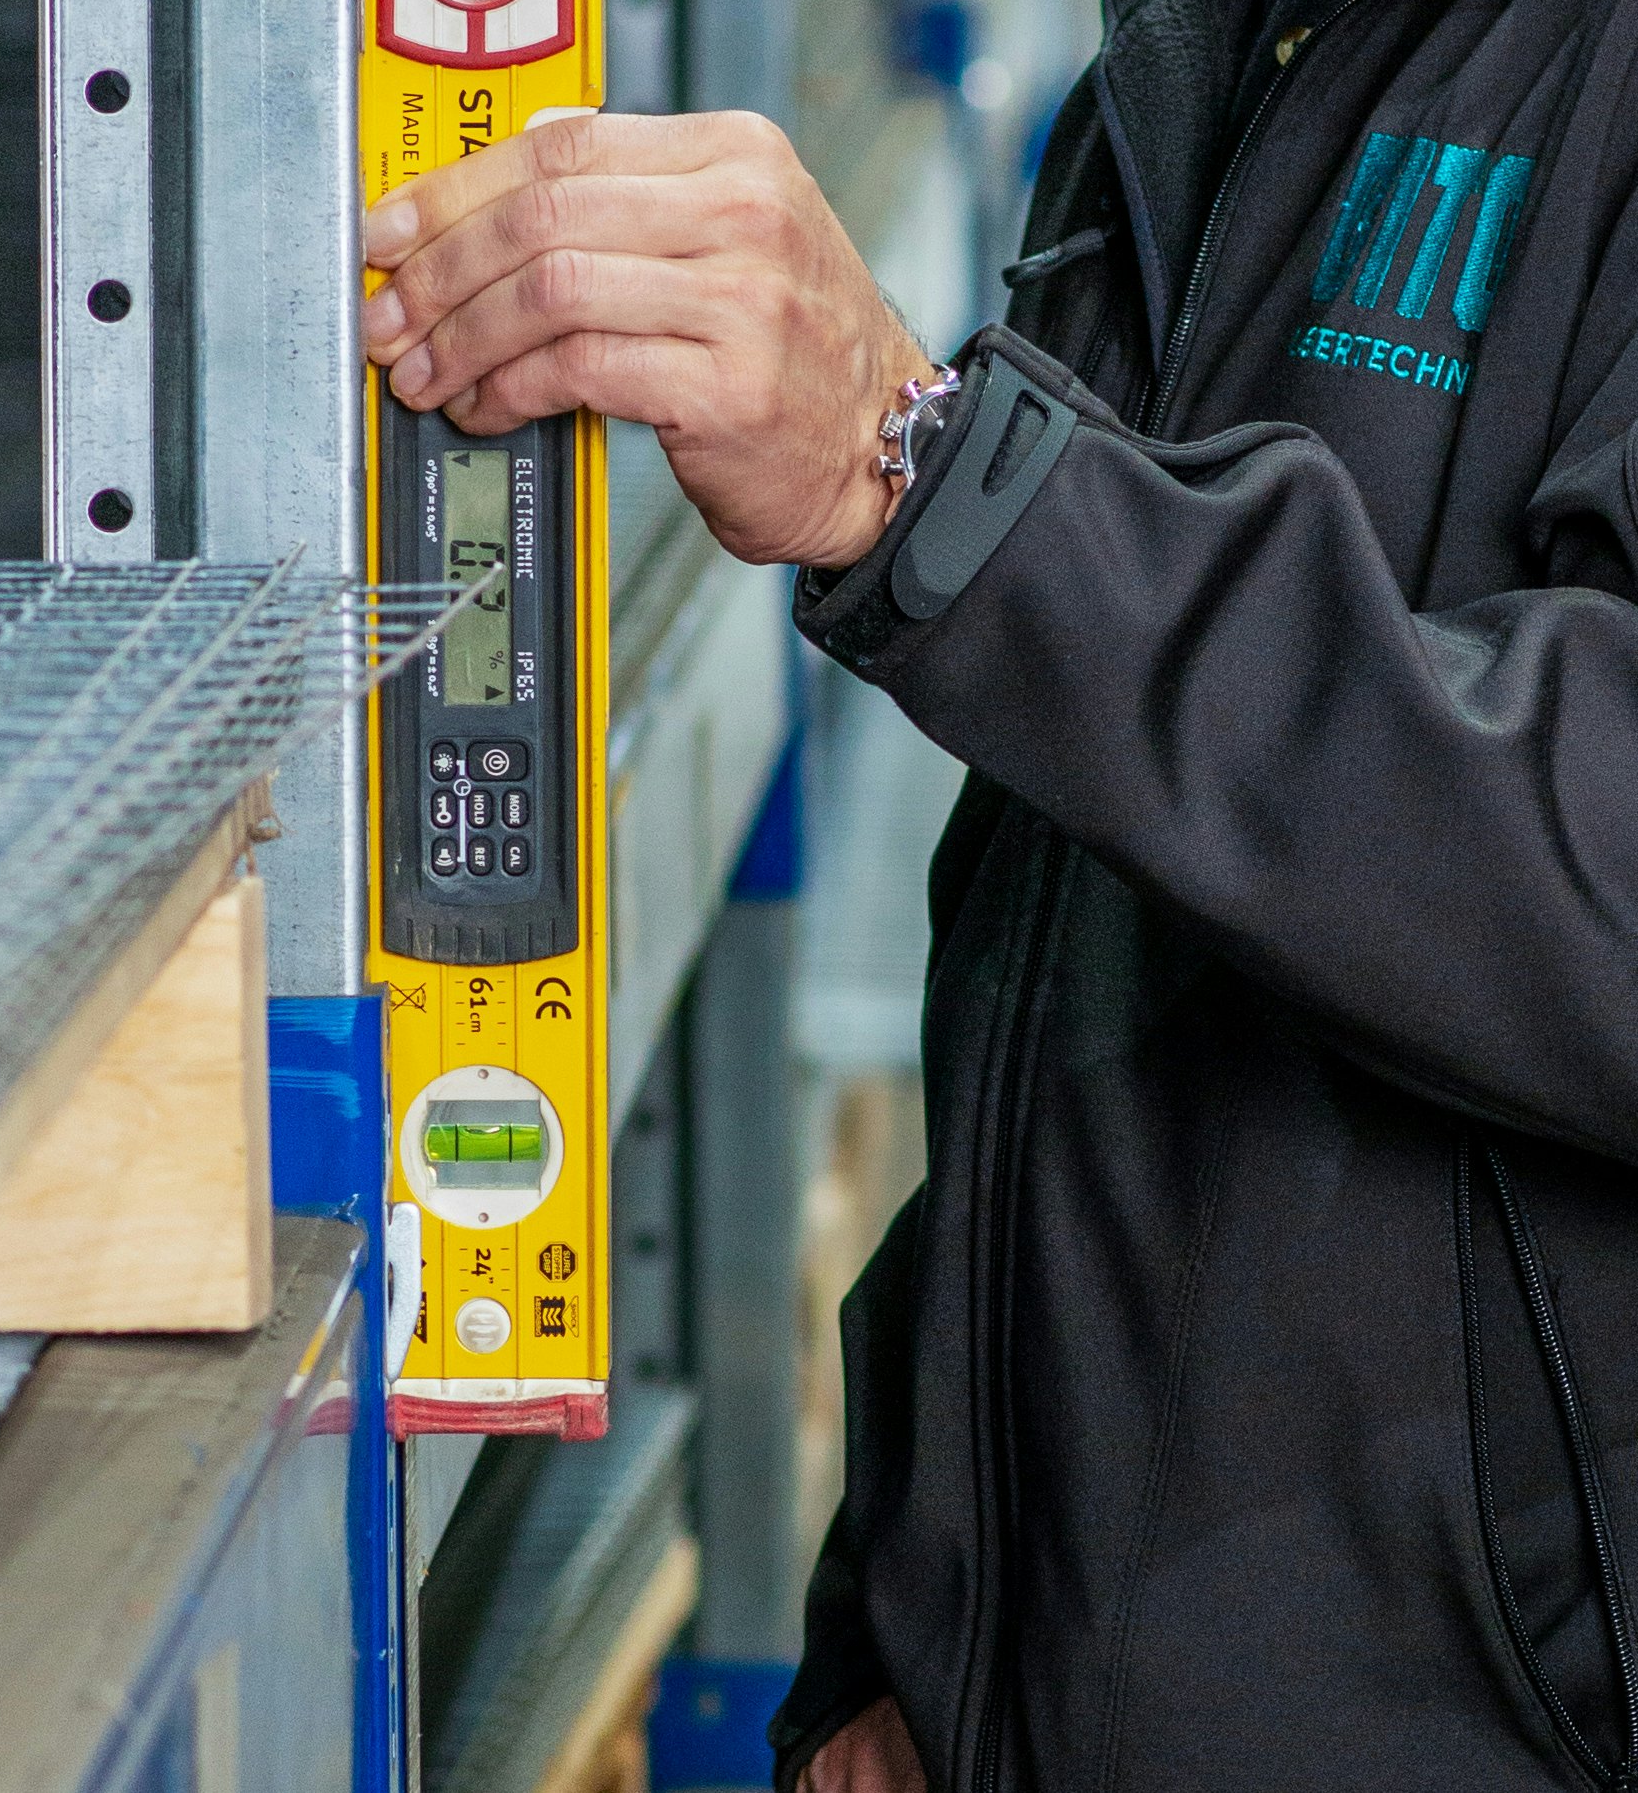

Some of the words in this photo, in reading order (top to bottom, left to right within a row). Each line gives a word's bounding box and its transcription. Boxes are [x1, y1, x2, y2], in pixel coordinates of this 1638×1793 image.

[515, 458, 534, 580] ELECTRONIC
[517, 651, 535, 702] IP65
[474, 794, 484, 824] HOLD
[509, 794, 520, 824] MODE
[474, 846, 485, 867] REF
[510, 846, 520, 867] CAL
[469, 977, 494, 1009] 61
[470, 1012, 483, 1033] cm
[553, 1247, 562, 1280] STOPPER
[563, 1249, 571, 1274] SURE
